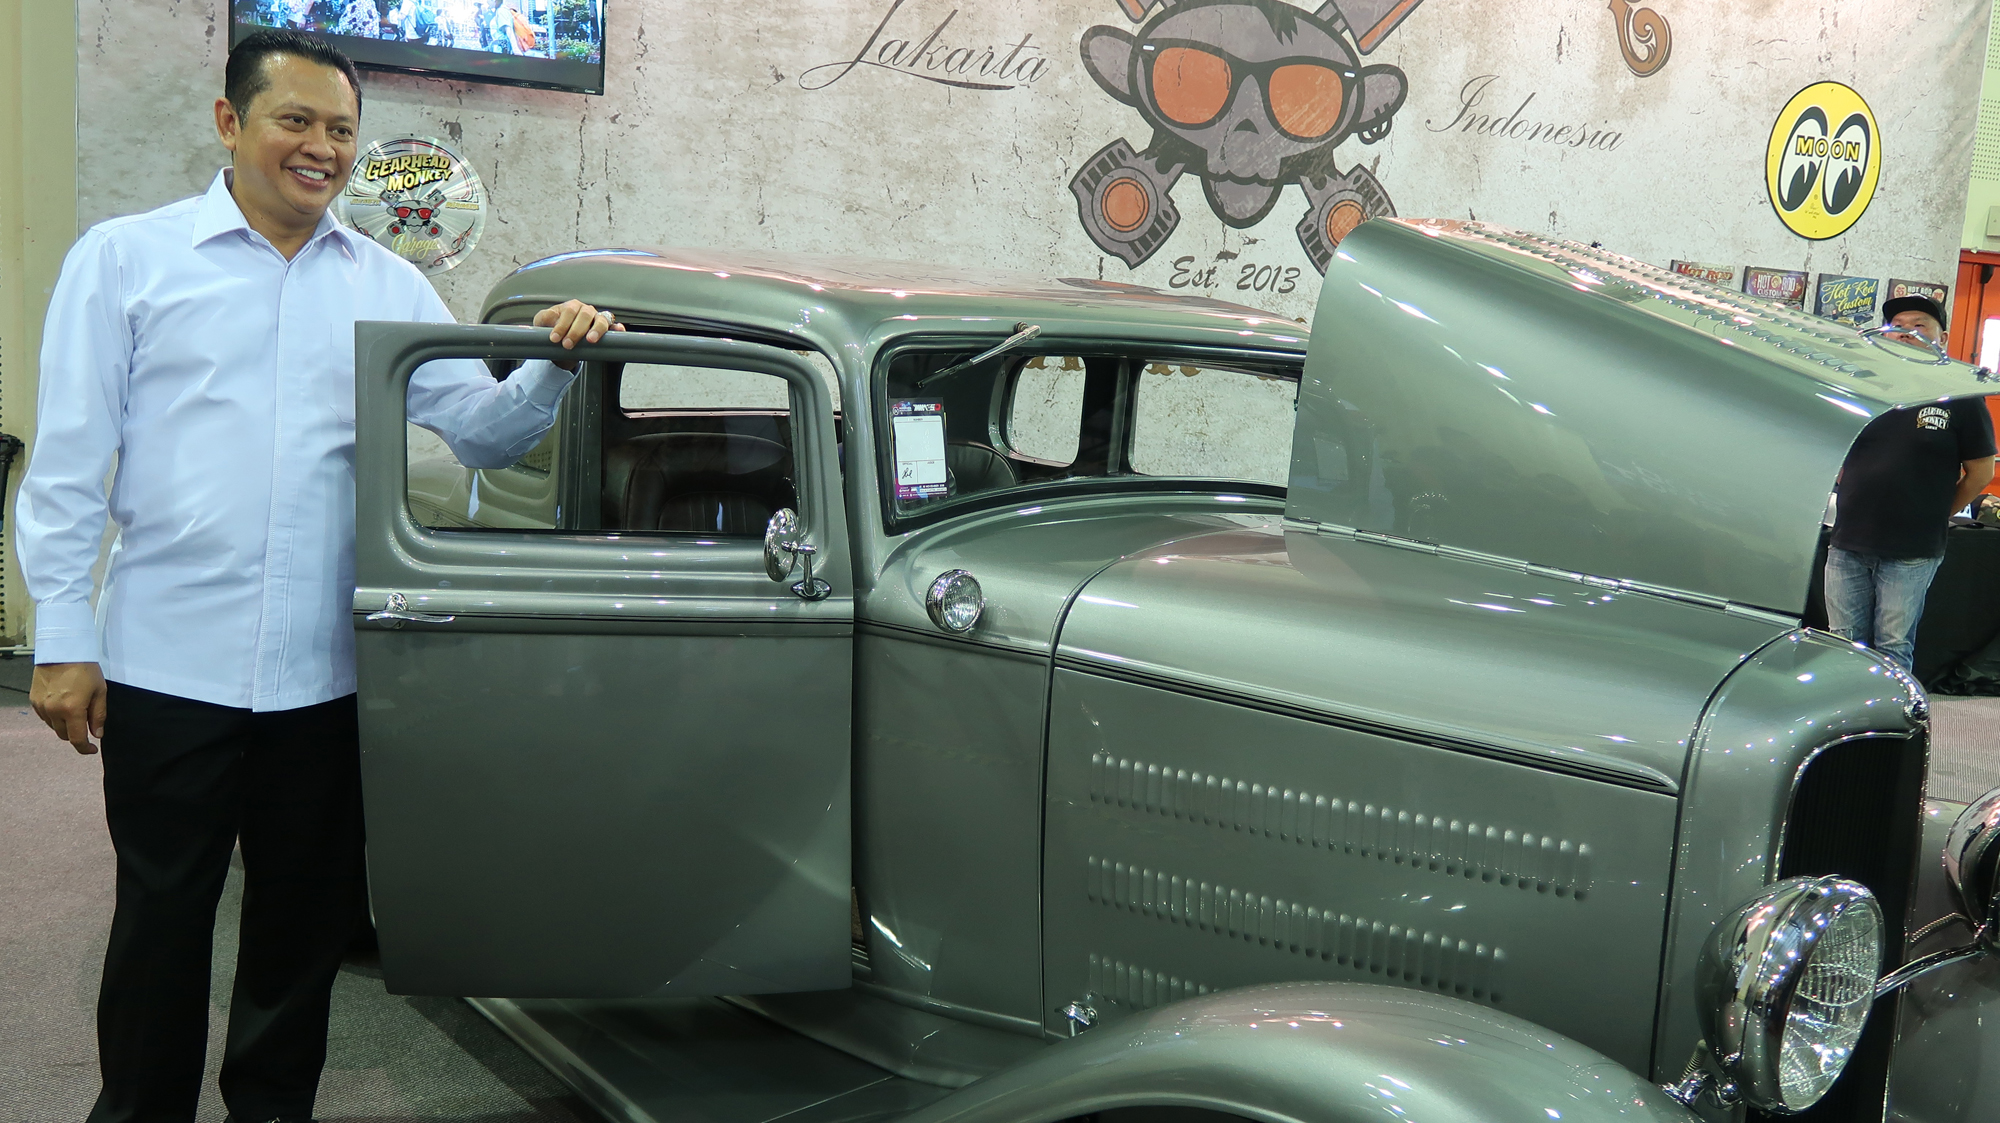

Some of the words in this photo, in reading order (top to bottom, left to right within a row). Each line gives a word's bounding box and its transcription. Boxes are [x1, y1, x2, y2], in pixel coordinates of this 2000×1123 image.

[799, 0, 1049, 91] Jakarta
[1425, 74, 1625, 151] Indonesia
[1795, 135, 1860, 162] MOON
[365, 154, 451, 181] GEARHEAD
[387, 168, 453, 193] MONKEY
[391, 233, 440, 259] Garage
[1169, 256, 1219, 288] Est.
[1236, 263, 1301, 293] 2013
[1756, 274, 1772, 289] HOT
[1821, 282, 1851, 304] Hot
[1852, 280, 1878, 297] Rod
[1835, 296, 1873, 312] Custom
